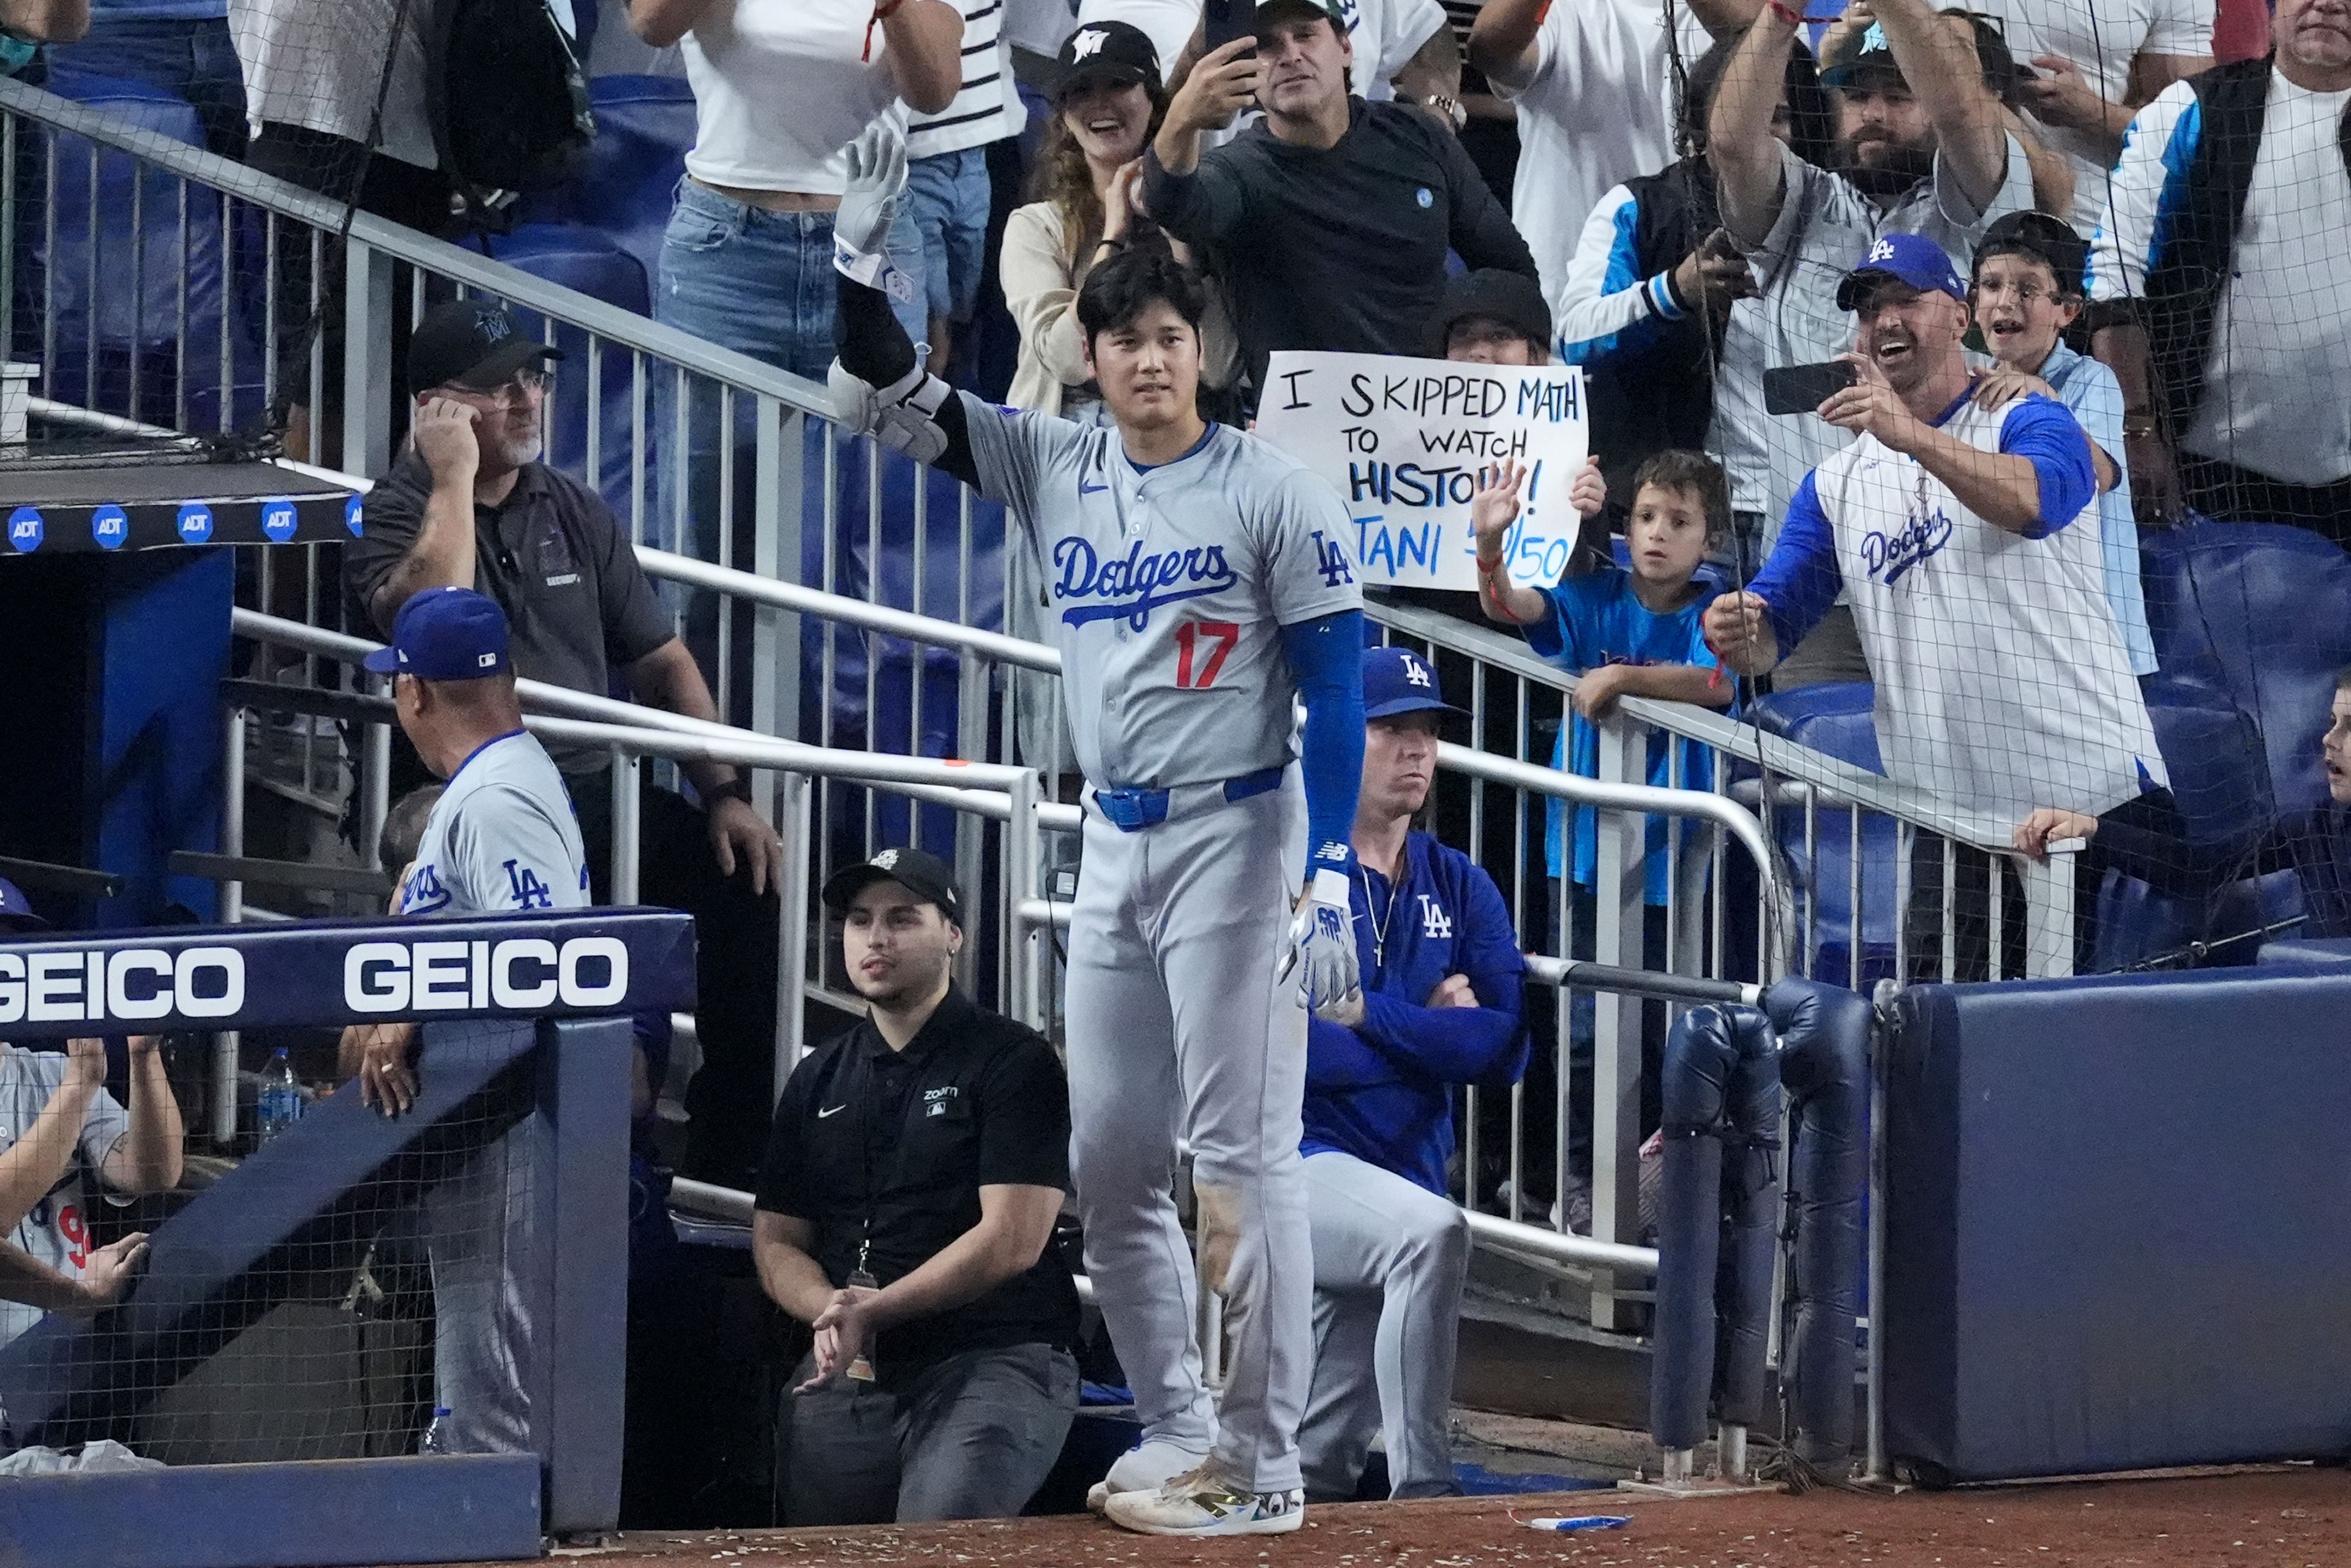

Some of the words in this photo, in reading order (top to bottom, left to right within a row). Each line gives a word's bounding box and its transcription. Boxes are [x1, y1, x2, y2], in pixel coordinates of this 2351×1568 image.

[1869, 238, 1895, 263] LA
[1280, 369, 1314, 410] I
[1341, 373, 1506, 418] SKIPPED
[1517, 374, 1580, 422] MATH
[1341, 427, 1379, 454] TO
[1419, 427, 1528, 458] WATCH
[13, 520, 39, 538] ADT
[97, 518, 123, 535] ADT
[182, 514, 208, 531] ADT
[267, 511, 292, 528] ADT
[1311, 530, 1354, 588] LA
[1353, 515, 1442, 578] TANI
[1054, 536, 1238, 633] Dodgers
[1175, 622, 1240, 688] 17
[1400, 655, 1431, 688] LA
[502, 858, 553, 910] LA
[1417, 895, 1452, 938] LA
[343, 937, 629, 1012] GEICO
[923, 1086, 958, 1100] zoom
